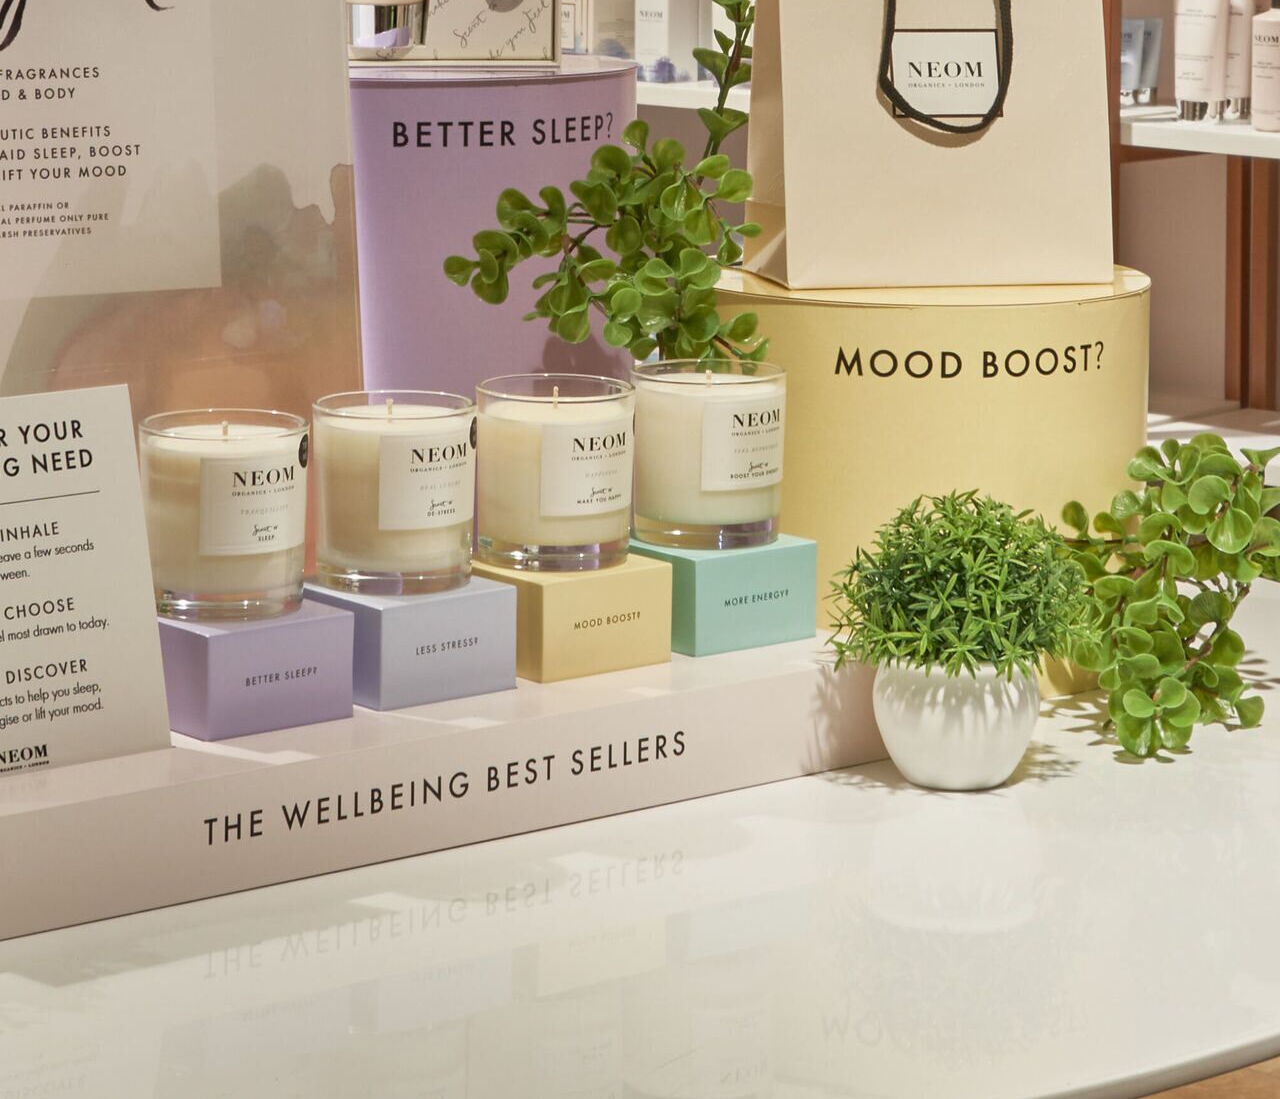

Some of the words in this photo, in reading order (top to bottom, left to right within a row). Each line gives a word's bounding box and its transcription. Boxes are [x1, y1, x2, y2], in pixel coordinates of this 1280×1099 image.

[907, 61, 984, 79] NEOM
[18, 88, 27, 101] &
[34, 87, 76, 100] BODY
[41, 126, 111, 140] BENEFITS
[393, 120, 516, 148] BETTER
[532, 111, 614, 145] SLEEP?
[33, 146, 82, 161] SLEEP,
[89, 144, 141, 158] BOOST
[29, 167, 71, 180] YOUR
[78, 165, 127, 178] MOOD
[834, 346, 962, 379] MOOD
[982, 341, 1104, 379] BOOST?
[732, 408, 780, 428] NEOM
[18, 419, 83, 446] YOUR
[573, 432, 626, 452] NEOM
[31, 448, 94, 475] NEED
[411, 442, 467, 464] NEOM
[232, 465, 294, 488] NEOM
[0, 521, 60, 543] INHALE
[24, 550, 31, 560] a
[33, 545, 52, 559] few
[54, 539, 95, 557] seconds
[724, 595, 748, 607] MORE
[752, 589, 789, 603] ENERGY?
[4, 597, 75, 622] CHOOSE
[574, 618, 603, 630] MOOD
[606, 611, 641, 625] BOOST?
[8, 628, 31, 642] most
[32, 623, 64, 640] drawn
[66, 621, 77, 633] to
[79, 616, 110, 634] today.
[416, 644, 437, 656] LESS
[441, 637, 479, 652] STRESS?
[5, 658, 88, 685] DISCOVER
[245, 672, 280, 687] BETTER
[285, 667, 317, 680] SLEEP?
[14, 693, 25, 706] to
[27, 687, 49, 706] help
[51, 687, 70, 702] you
[72, 681, 102, 697] sleep,
[22, 711, 33, 723] or
[35, 707, 46, 722] lift
[48, 705, 70, 722] your
[73, 698, 104, 715] mood.
[204, 809, 265, 846] THE
[282, 771, 470, 831] WELLBEING
[486, 755, 556, 793] BEST
[570, 730, 687, 776] SELLERS
